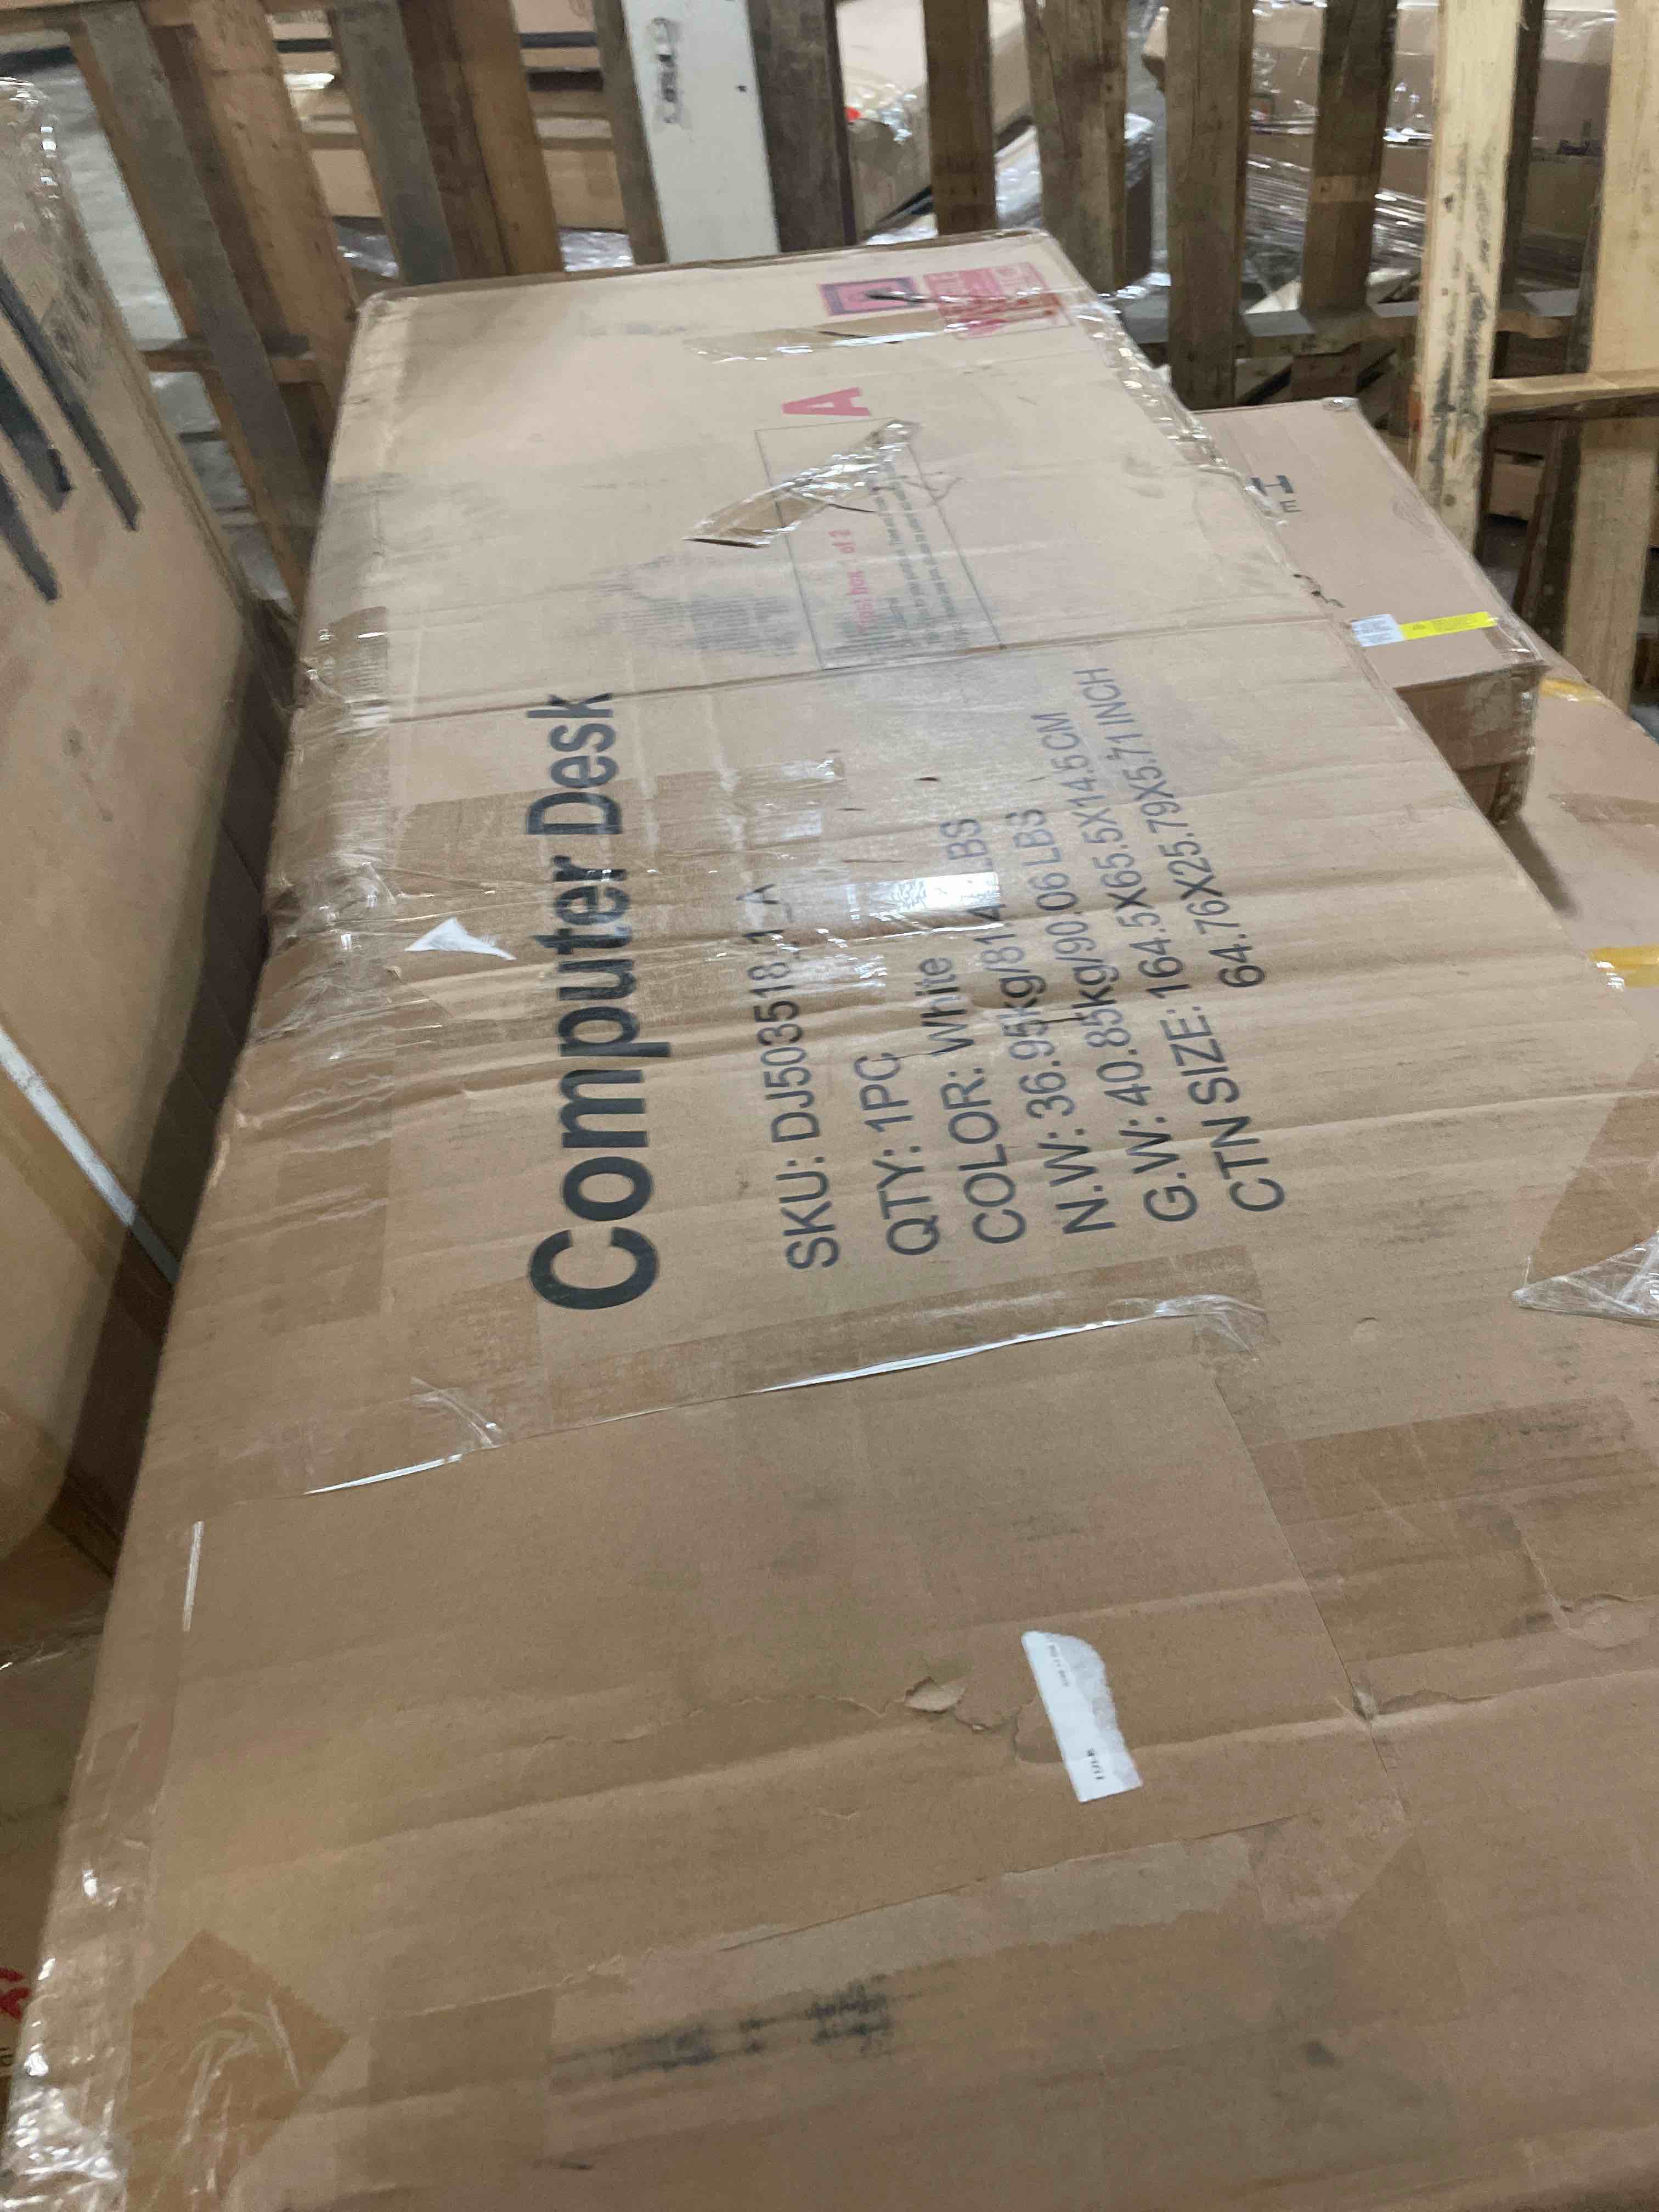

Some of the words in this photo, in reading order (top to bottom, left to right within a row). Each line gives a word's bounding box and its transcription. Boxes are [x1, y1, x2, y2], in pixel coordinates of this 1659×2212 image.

[782, 386, 871, 416] A
[1030, 712, 1080, 752] CM
[1073, 667, 1136, 725] INCH
[526, 692, 623, 835] Desk
[939, 817, 994, 871] BS
[1005, 808, 1063, 866] LBS
[1050, 754, 1192, 999] 164.5X65.5X14.5
[1104, 733, 1266, 989] 64.76X25.79X5.71
[915, 956, 974, 1057] White
[963, 884, 1075, 1119] 36.95kg/81.4
[1028, 872, 1152, 1107] 40.85kg/90.06
[528, 855, 671, 1310] Computer
[854, 1052, 915, 1133] 1PC
[1159, 1006, 1240, 1105] SIZE:
[872, 1146, 940, 1256] QTY:
[940, 1067, 1026, 1244] COLOR:
[1037, 1127, 1116, 1234] N.W:
[1119, 1116, 1198, 1222] G.W:
[1201, 1115, 1285, 1212] CTN
[775, 1156, 839, 1269] SKU:
